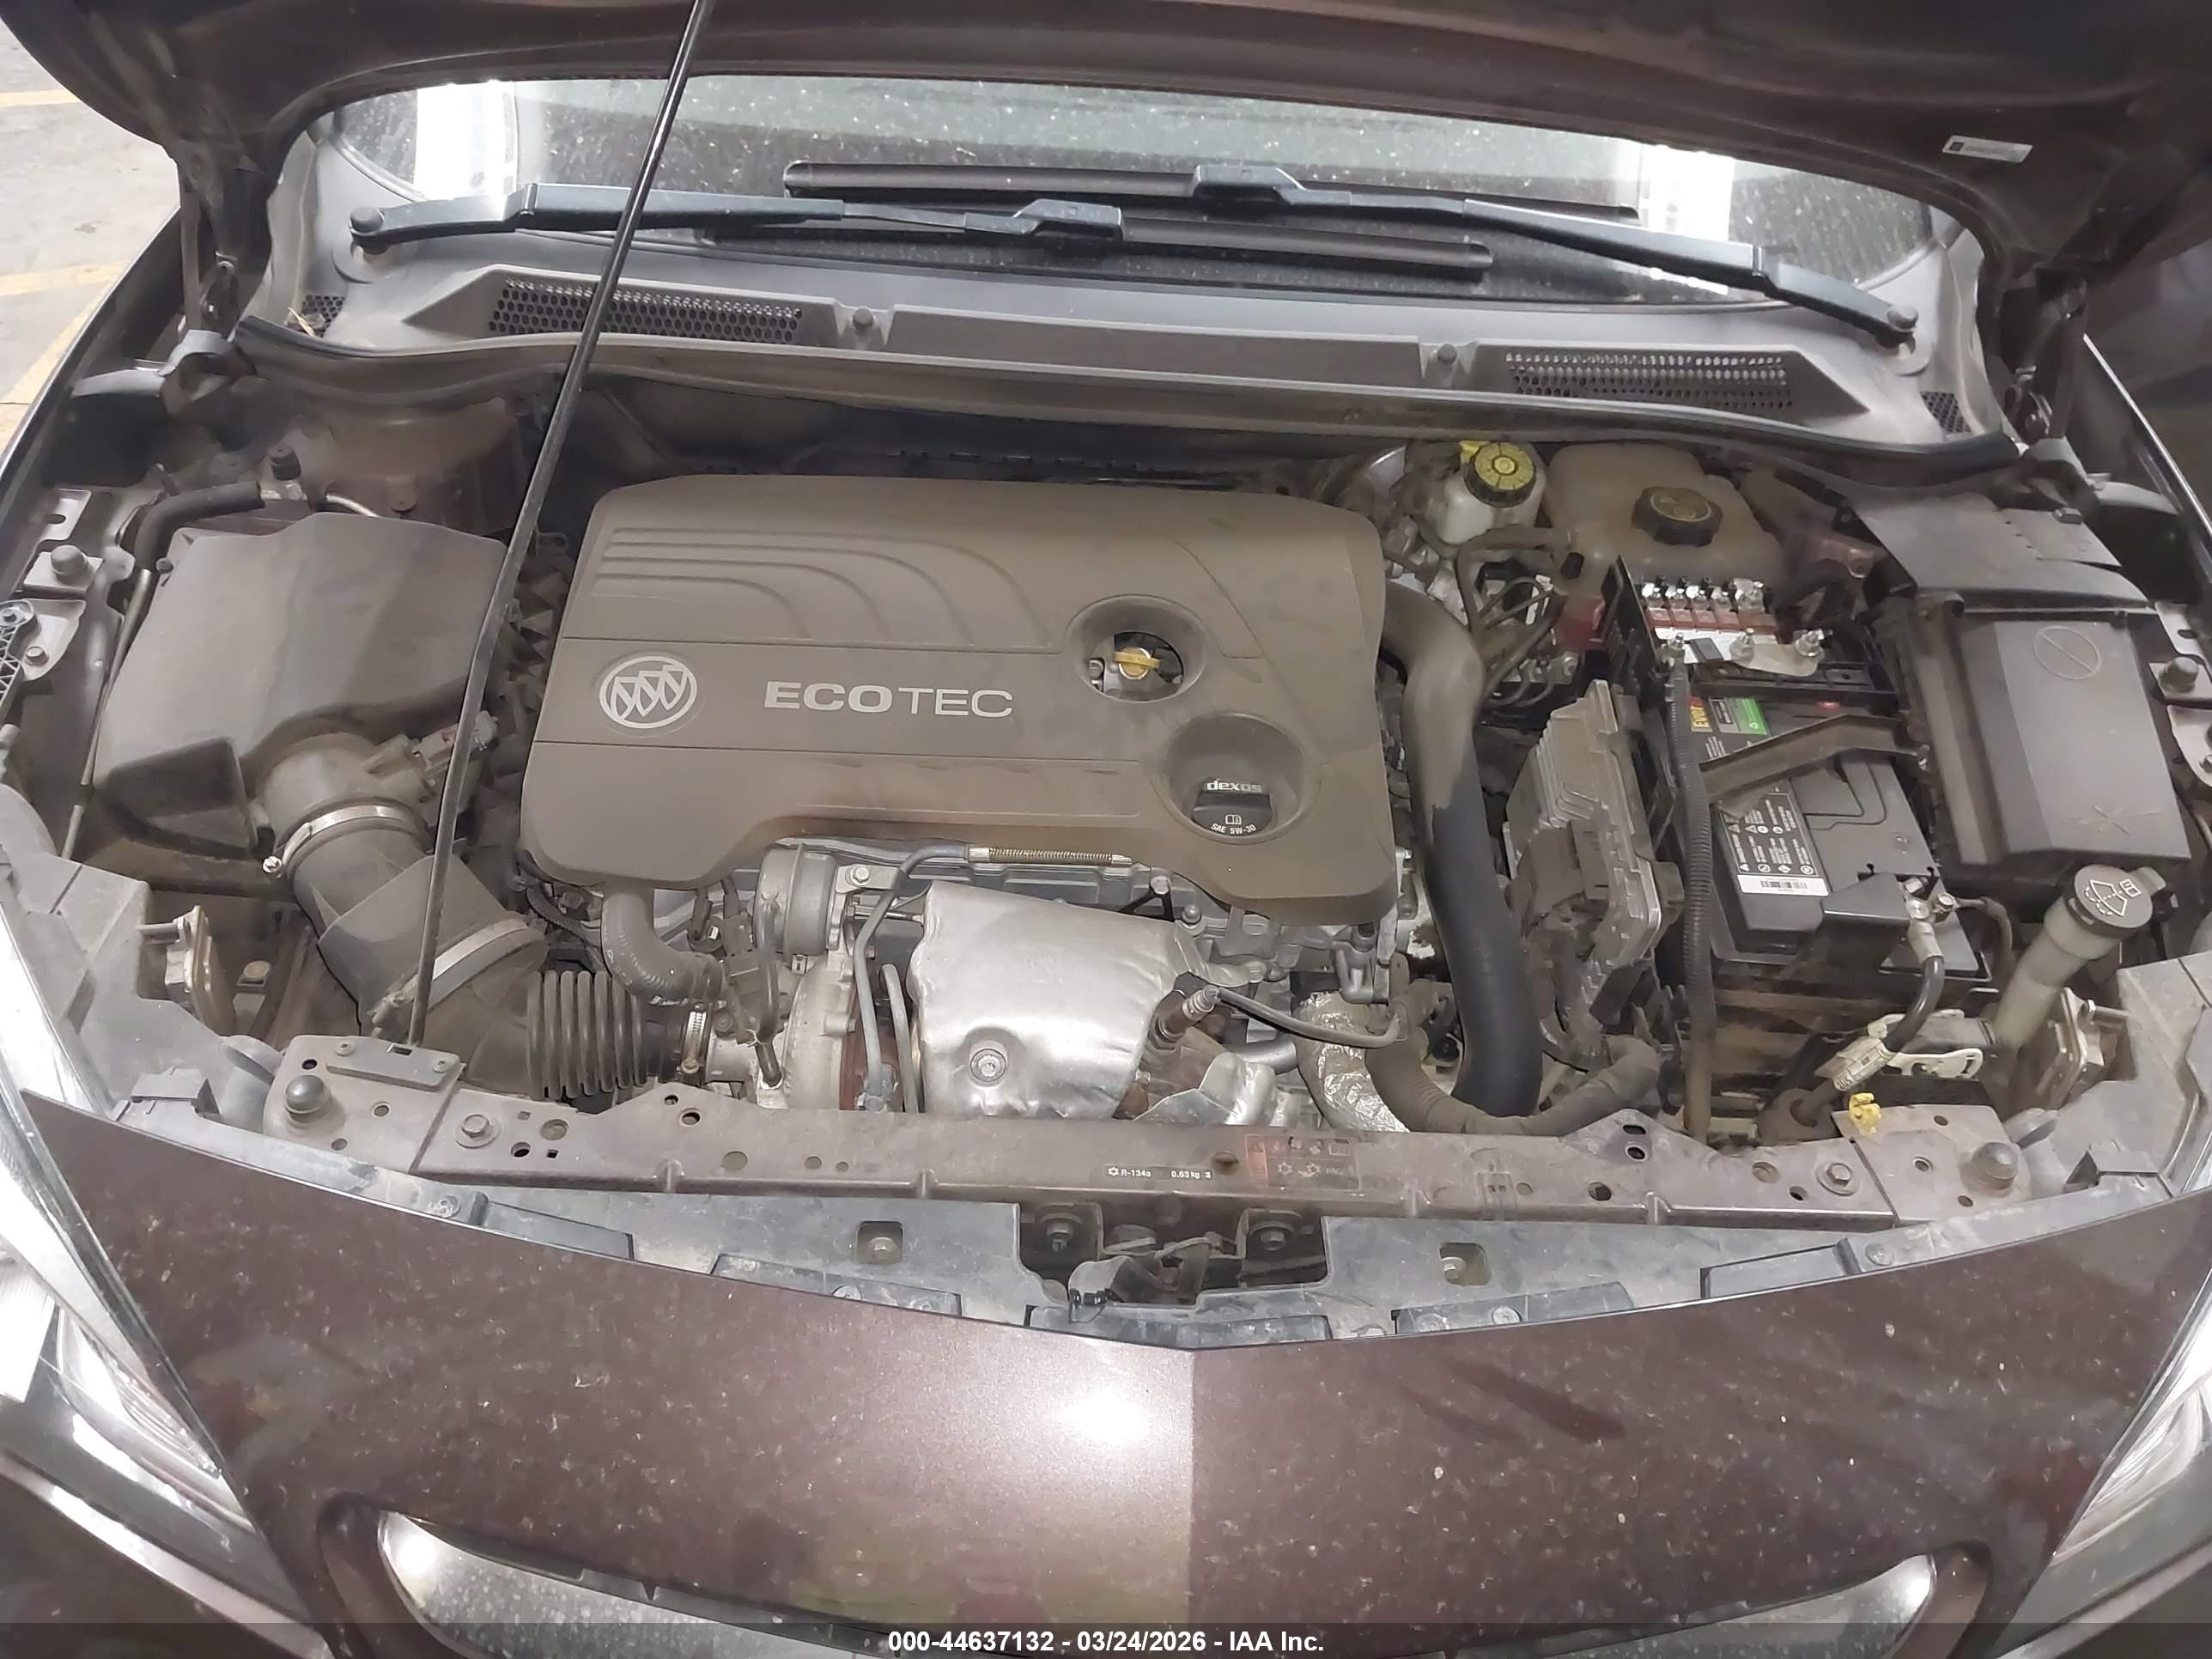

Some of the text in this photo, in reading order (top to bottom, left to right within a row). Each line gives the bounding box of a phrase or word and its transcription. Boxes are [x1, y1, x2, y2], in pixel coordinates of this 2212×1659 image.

[763, 680, 1014, 718] ECOTEC
[1206, 779, 1263, 793] dexos
[1211, 823, 1257, 836] SAE 5W-30
[1121, 1169, 1152, 1178] R-134a
[1170, 1170, 1189, 1179] 0.63
[1190, 1170, 1200, 1180] kg
